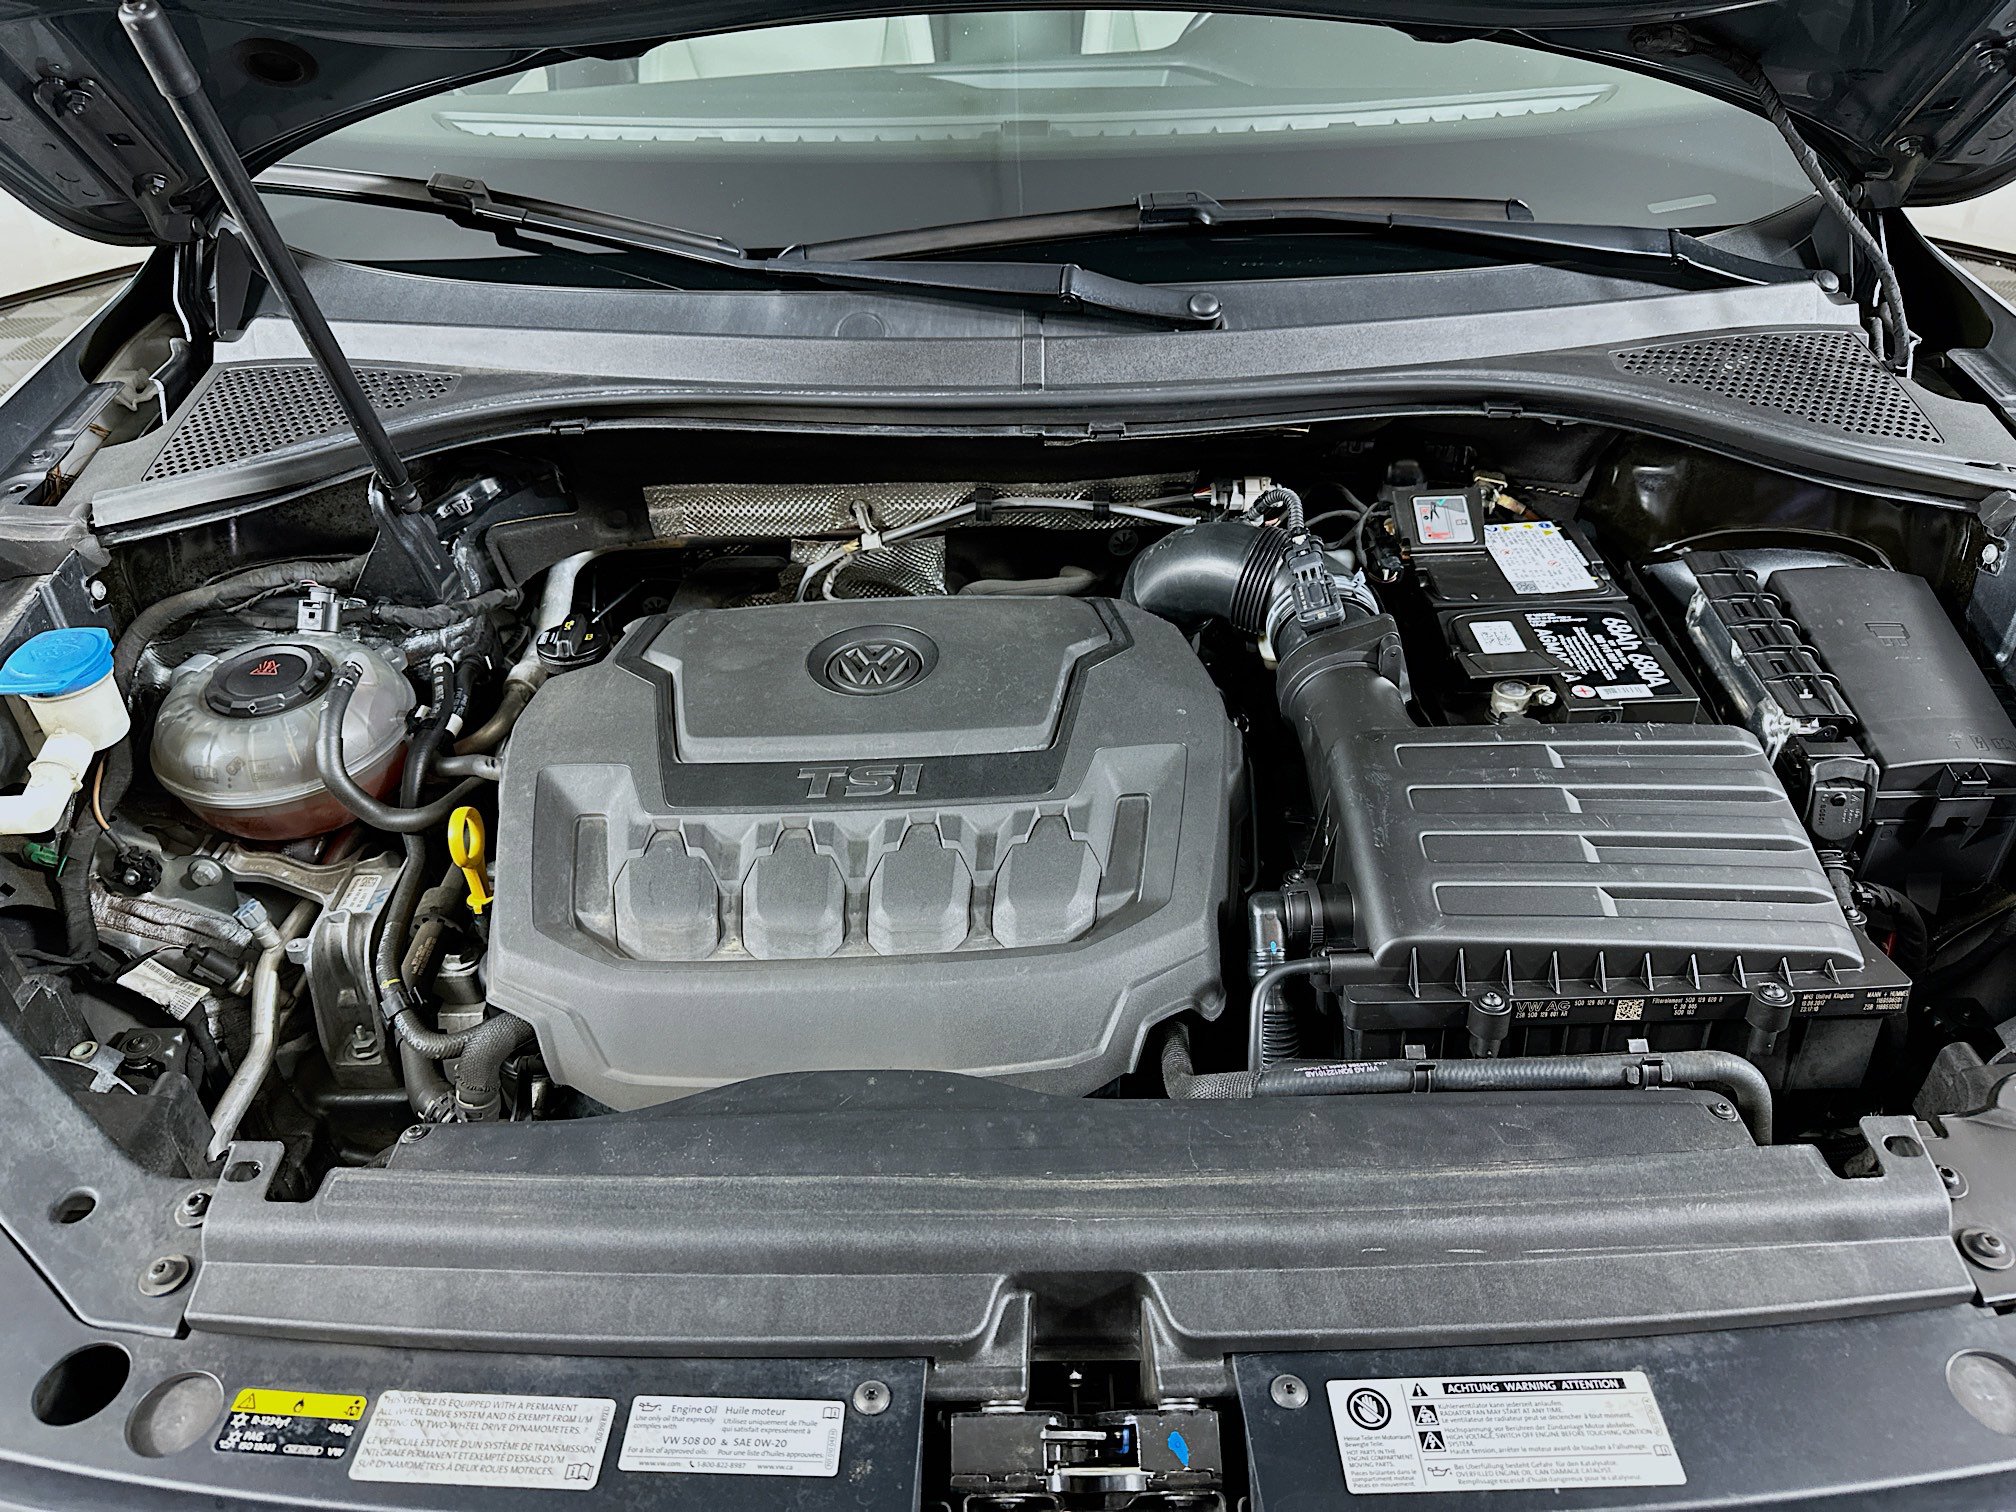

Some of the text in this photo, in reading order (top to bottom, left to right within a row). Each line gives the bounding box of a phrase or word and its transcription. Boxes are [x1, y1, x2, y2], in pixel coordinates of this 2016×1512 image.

[1602, 618, 1642, 651] 68Ah
[1627, 654, 1670, 688] 680A
[797, 763, 923, 798] TSI
[1516, 1001, 1571, 1012] VW AG
[1447, 1379, 1620, 1393] ACHTUNG WARNING ATTENTION
[404, 1397, 437, 1405] VEHICLE
[449, 1399, 491, 1409] EQUIPPED
[493, 1401, 516, 1409] WITH
[526, 1402, 578, 1411] PERMANENT
[426, 1409, 451, 1418] DRIVE
[454, 1411, 486, 1419] SYSTEM
[486, 1412, 506, 1420] AND
[517, 1413, 551, 1421] EXEMPT
[552, 1415, 576, 1423] FROM
[671, 1405, 786, 1416] Engine Oil Huile moteur
[250, 1415, 292, 1429] R-1234yf
[426, 1420, 479, 1430] TWO-WHEEL
[481, 1422, 507, 1431] DRIVE
[509, 1423, 581, 1434] DYNAMOMETERS.
[242, 1431, 265, 1441] PAG
[663, 1436, 680, 1444] VW
[682, 1437, 700, 1445] 508
[703, 1437, 716, 1445] 00
[733, 1438, 752, 1447] SAE
[754, 1438, 787, 1448] 0W-20
[327, 1447, 345, 1457] VW
[535, 1443, 596, 1453] TRANSMISSION
[407, 1449, 458, 1458] PERMANENT
[458, 1452, 469, 1460] ET
[454, 1463, 479, 1471] DEUX
[480, 1464, 508, 1473] ROUES
